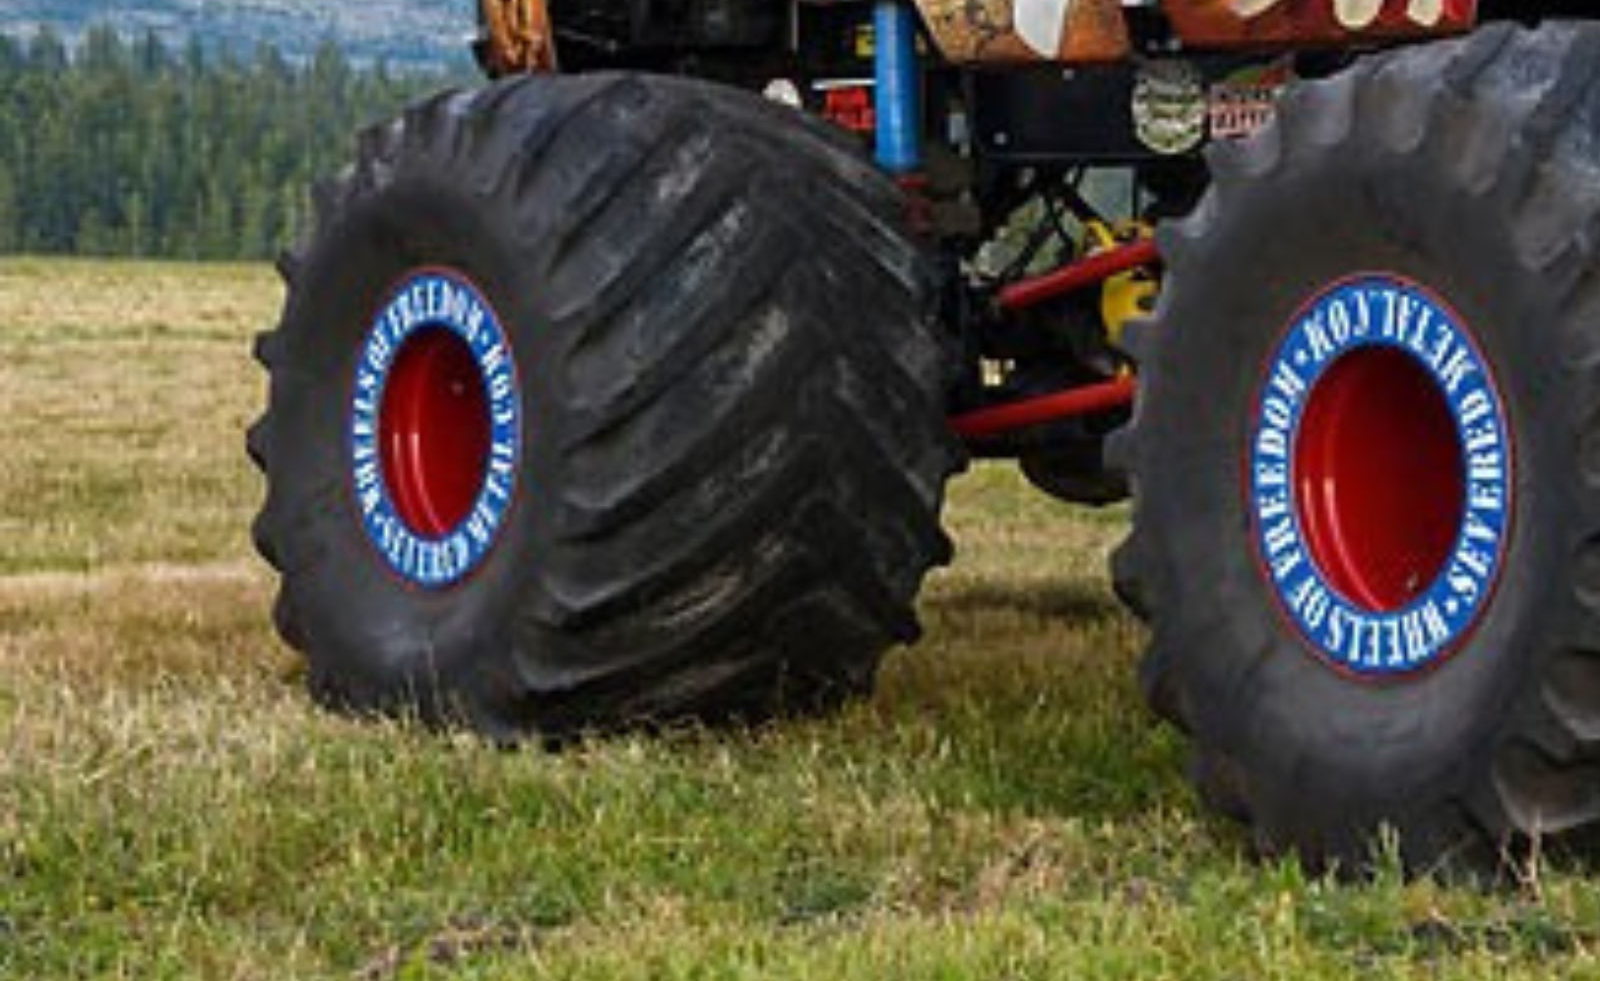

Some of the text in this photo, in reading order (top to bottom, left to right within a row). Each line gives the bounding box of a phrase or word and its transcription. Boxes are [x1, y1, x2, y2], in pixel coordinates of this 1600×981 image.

[1257, 363, 1450, 668] WHEELS OF FREEDOM
[1447, 388, 1502, 603] SEVERED
